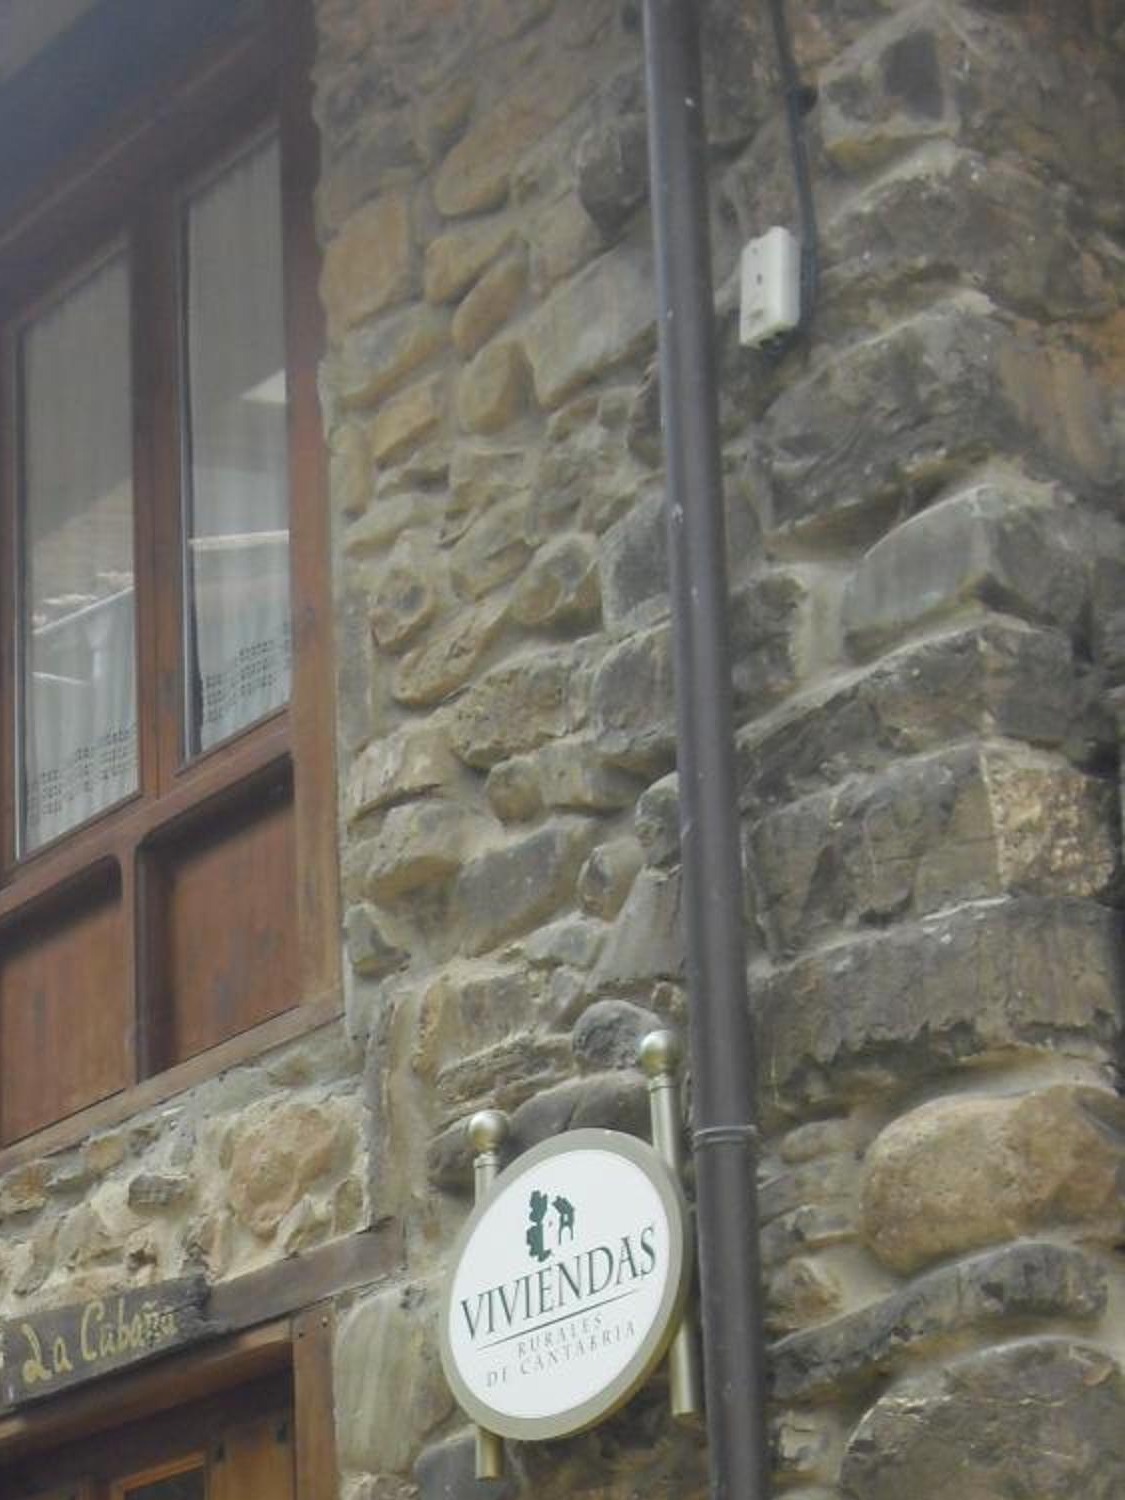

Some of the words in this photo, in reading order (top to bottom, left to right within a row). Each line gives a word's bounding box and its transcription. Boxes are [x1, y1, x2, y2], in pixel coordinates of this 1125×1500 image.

[460, 1225, 657, 1341] VIVIENDAS
[485, 1366, 509, 1389] DE
[519, 1320, 637, 1376] CANTABRIA
[517, 1311, 603, 1359] RURALES
